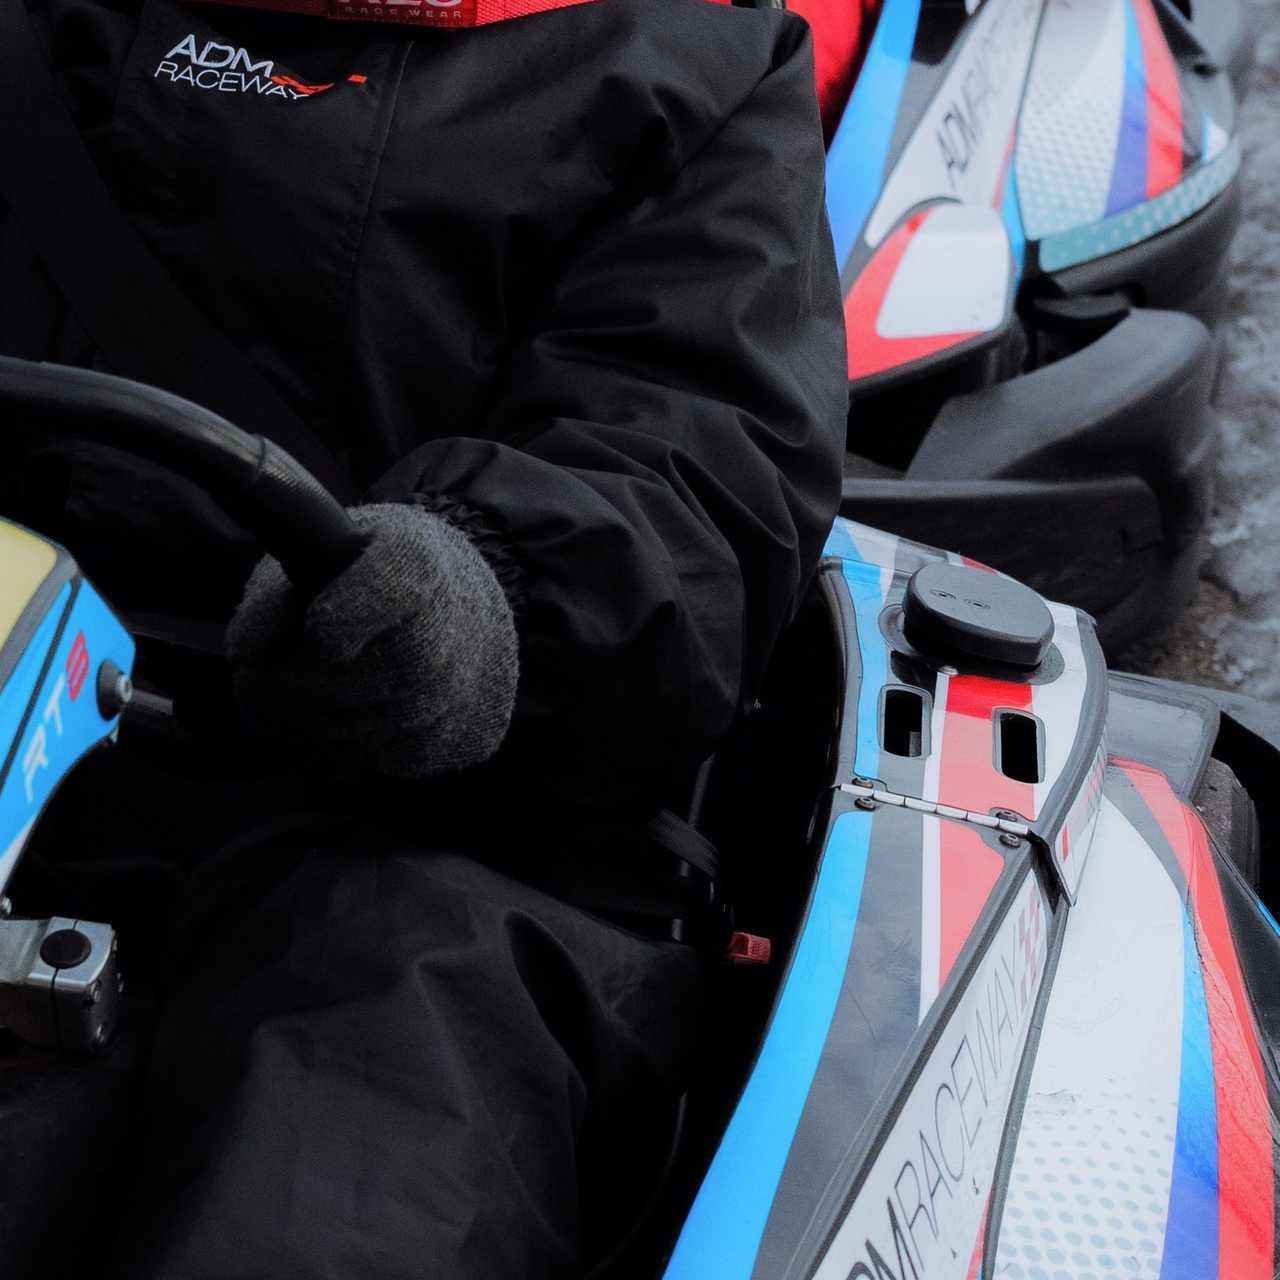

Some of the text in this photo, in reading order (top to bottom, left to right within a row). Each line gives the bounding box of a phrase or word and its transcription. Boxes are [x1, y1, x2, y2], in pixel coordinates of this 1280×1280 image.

[345, 6, 462, 18] RACE WEAR
[165, 34, 274, 77] ADM
[154, 61, 310, 99] RACEWAY
